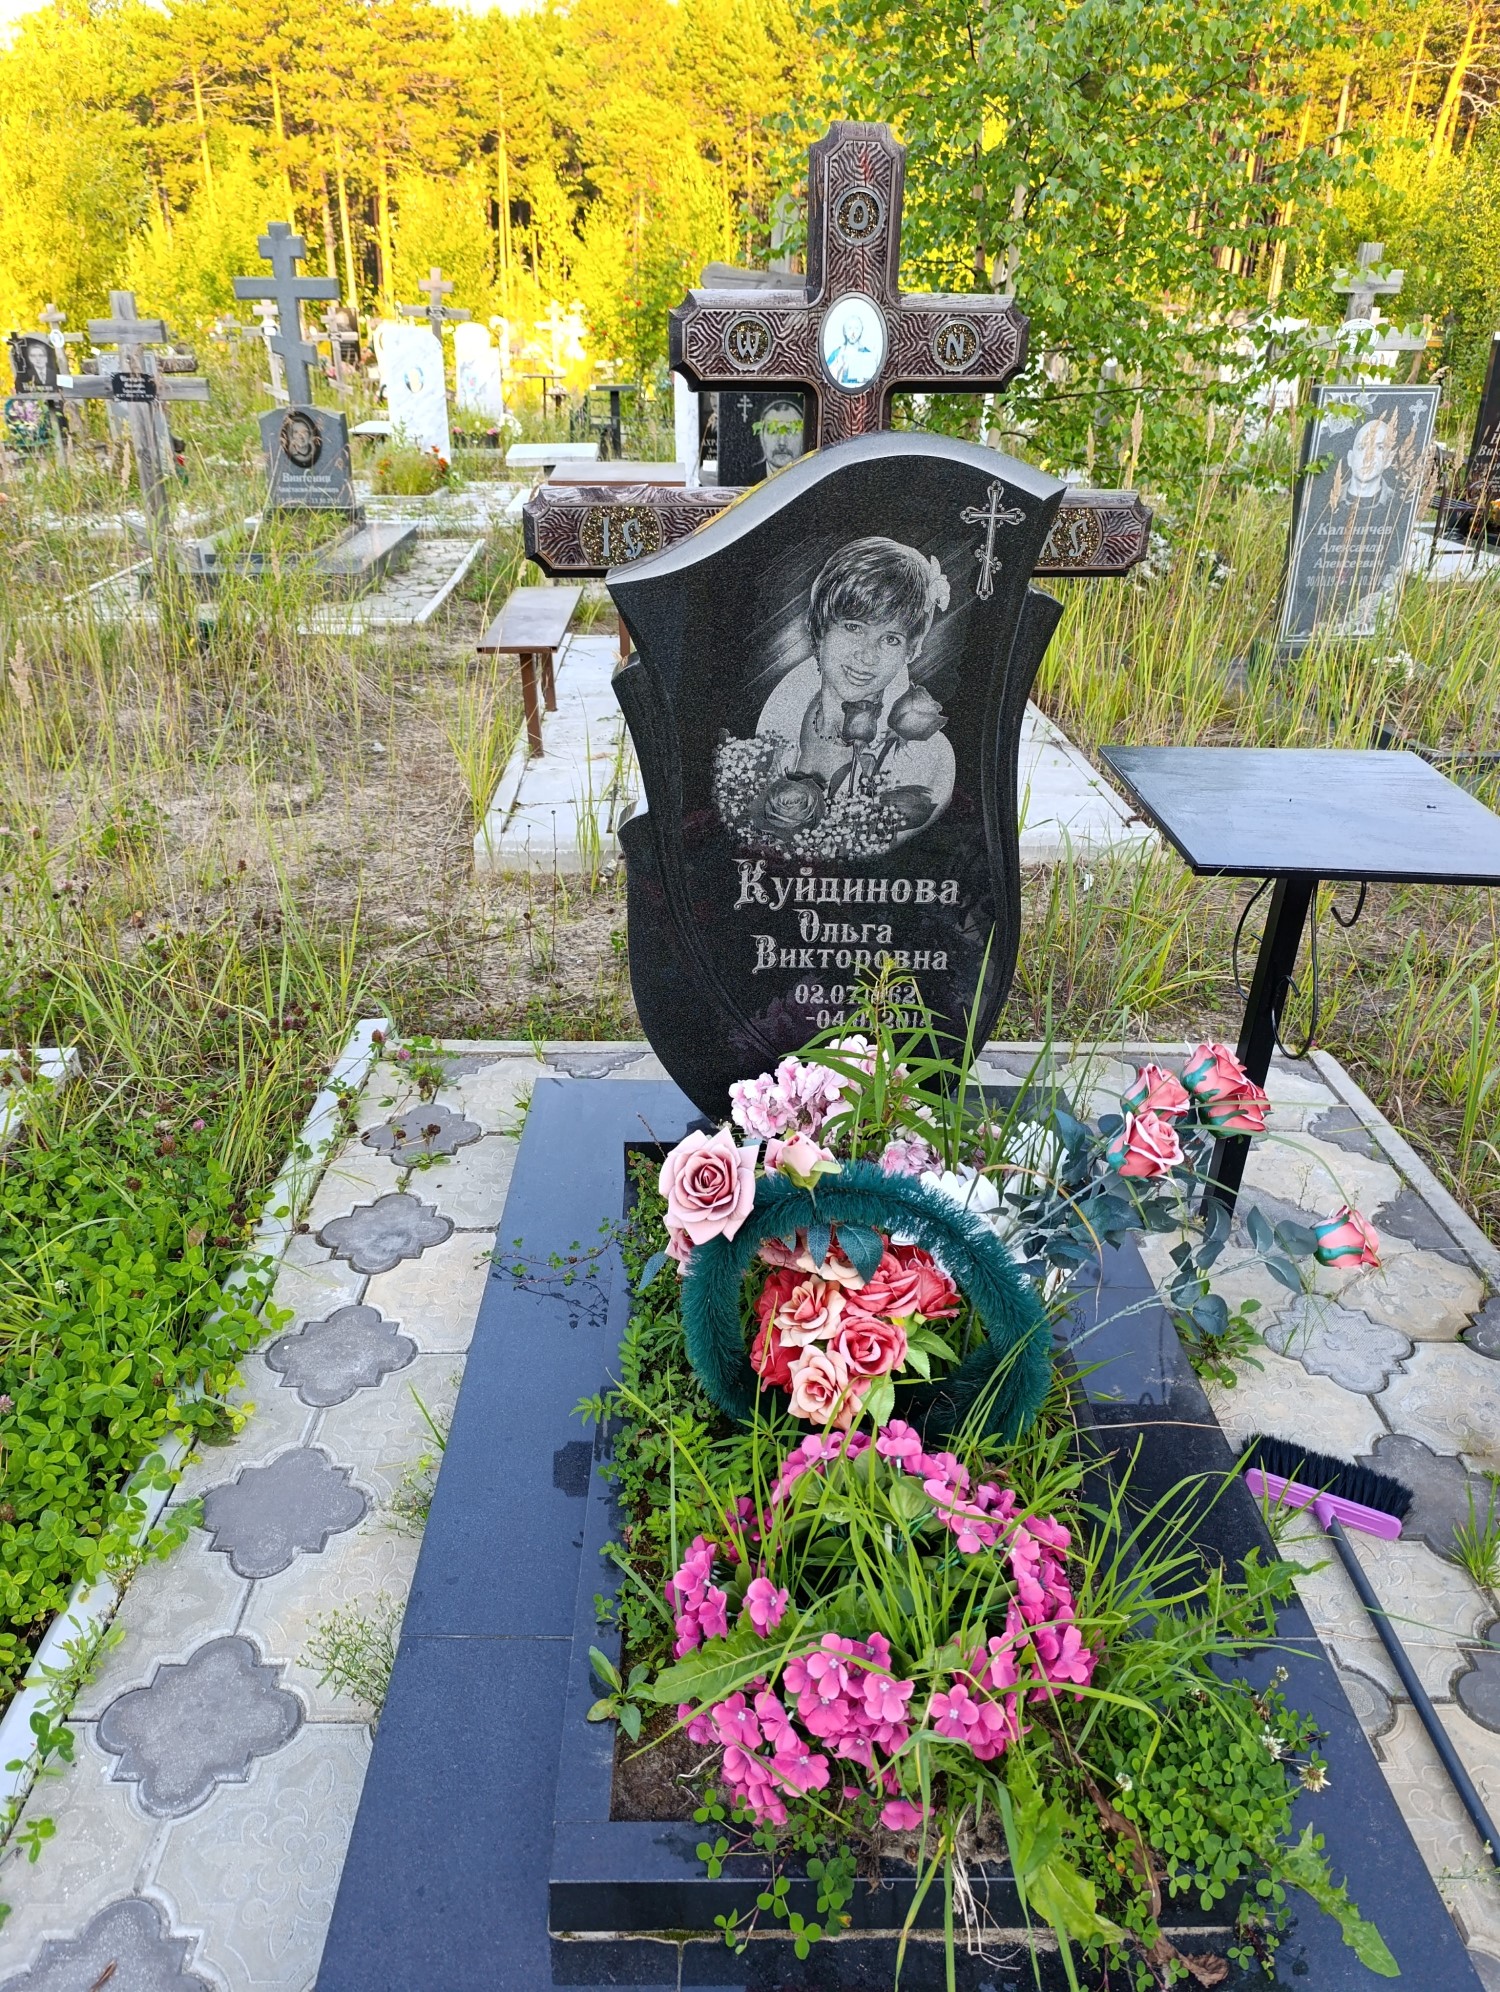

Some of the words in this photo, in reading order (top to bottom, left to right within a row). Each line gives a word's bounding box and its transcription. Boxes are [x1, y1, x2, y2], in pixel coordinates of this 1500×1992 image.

[731, 859, 961, 911] Куйдинова
[792, 908, 893, 944] Ольга
[750, 934, 949, 977] Викторовна
